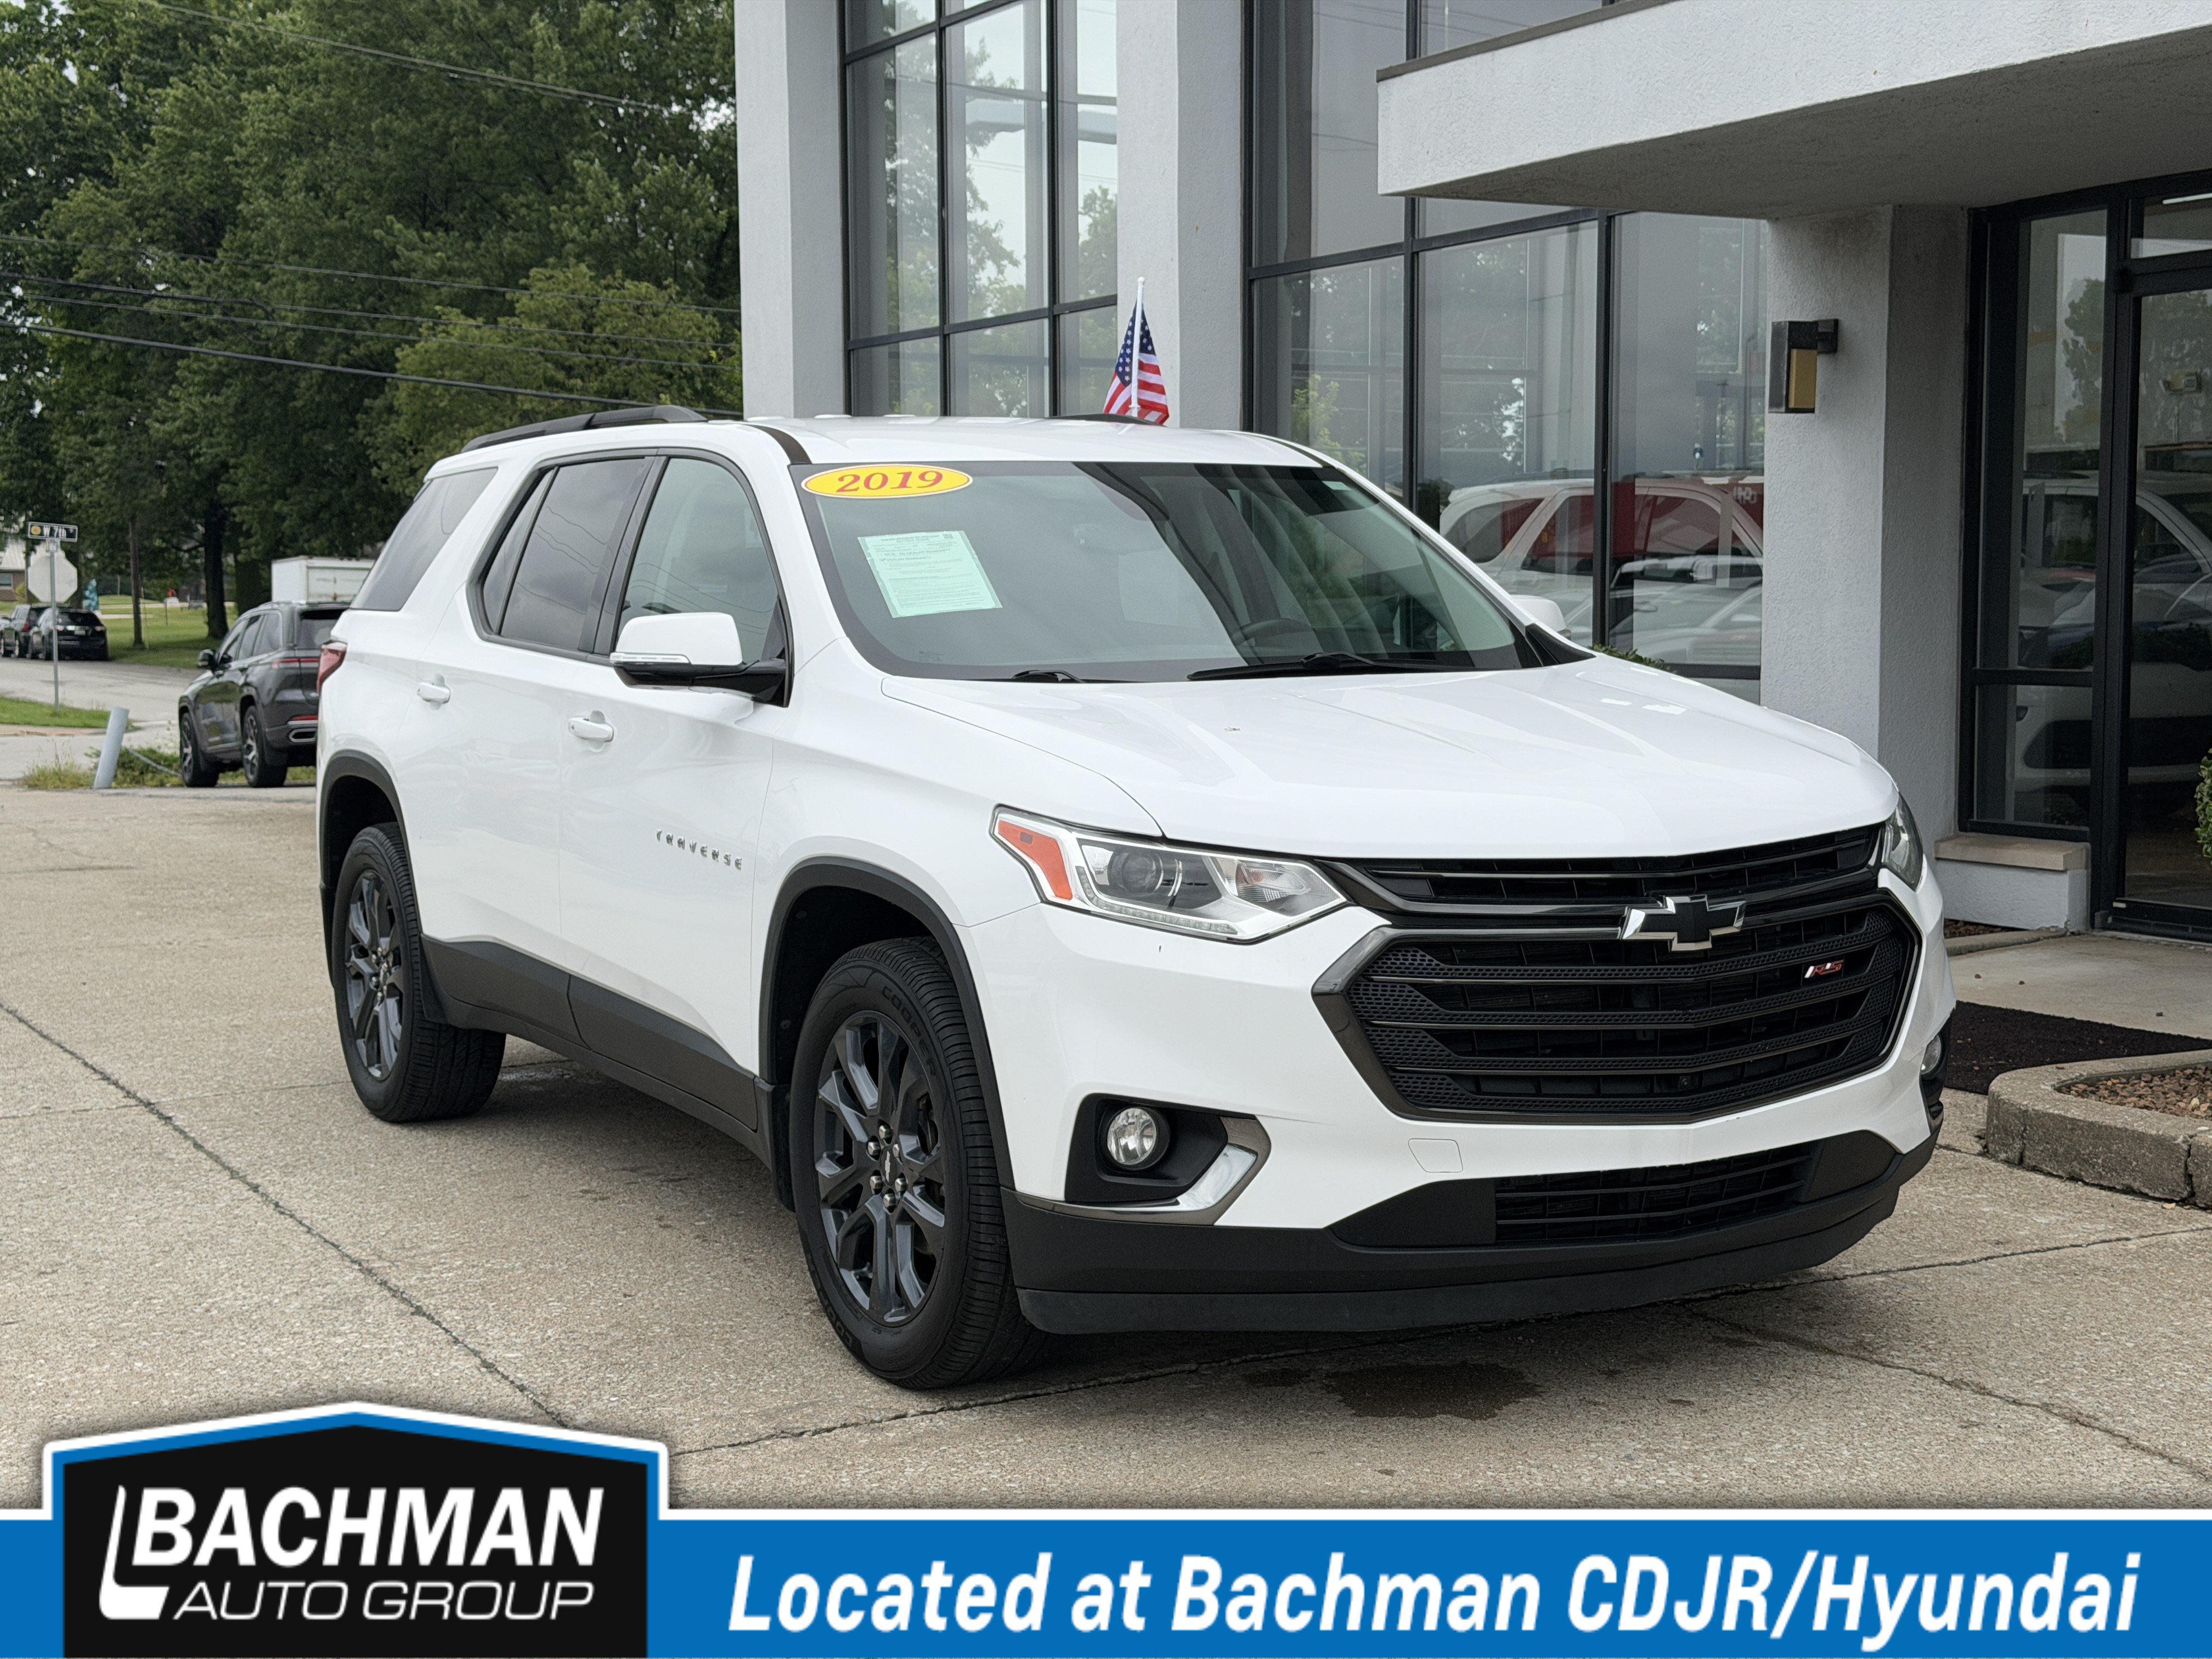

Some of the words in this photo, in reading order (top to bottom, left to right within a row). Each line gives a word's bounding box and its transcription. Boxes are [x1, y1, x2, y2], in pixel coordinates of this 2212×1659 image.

[836, 471, 943, 493] 2019
[43, 525, 50, 537] W
[656, 829, 742, 870] TRAVERSE
[1804, 960, 1844, 979] RS
[881, 985, 936, 1076] COOPER
